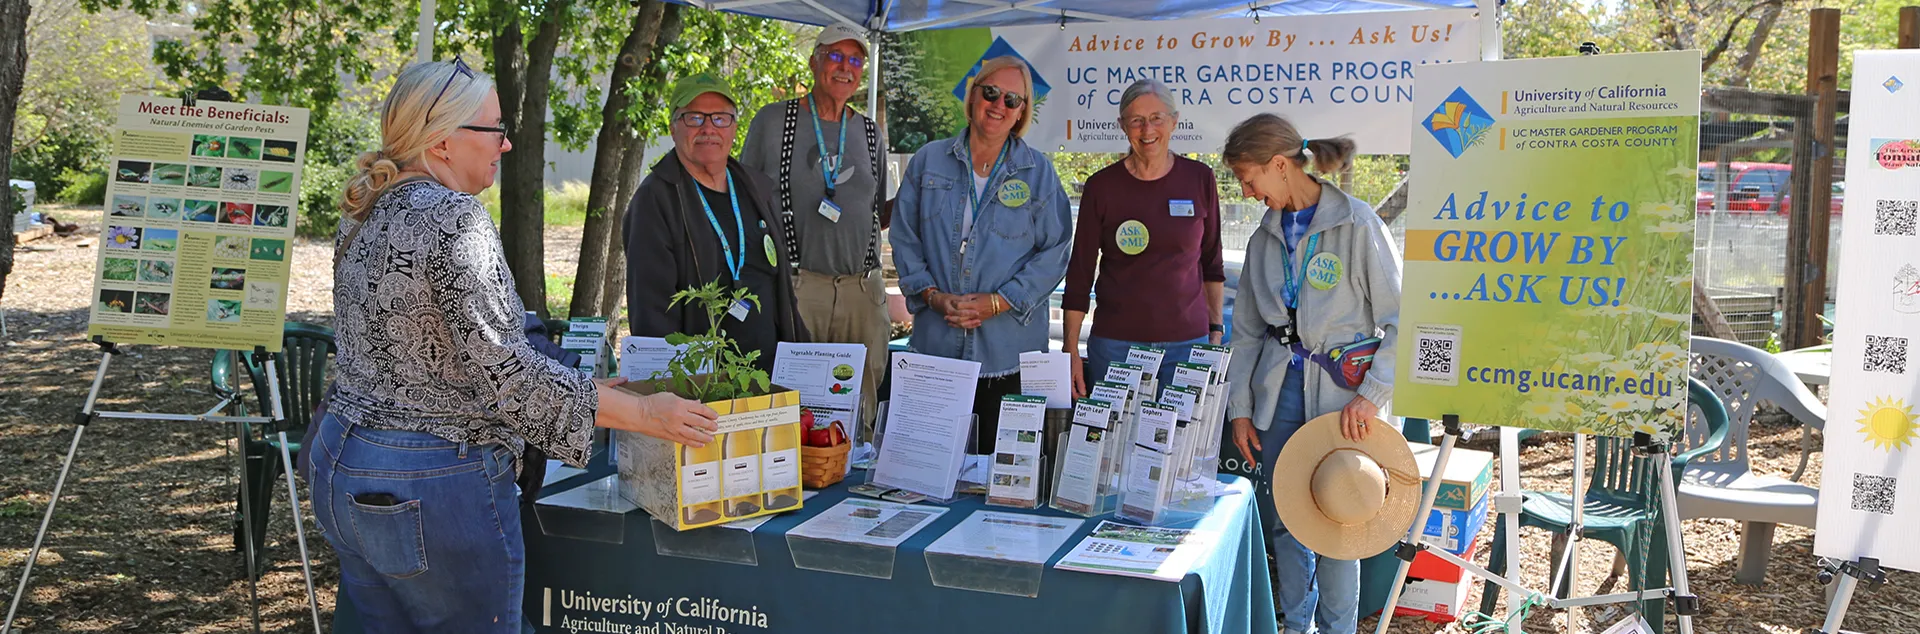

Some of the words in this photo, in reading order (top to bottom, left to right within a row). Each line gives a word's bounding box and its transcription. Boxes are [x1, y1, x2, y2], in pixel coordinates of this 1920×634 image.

[1068, 35, 1145, 52] Advice
[1157, 34, 1178, 50] to
[1191, 31, 1255, 49] Grow
[1266, 29, 1296, 52] By
[1349, 25, 1396, 45] Ask
[1411, 24, 1453, 43] Us!
[1067, 67, 1097, 84] UC
[1107, 66, 1187, 84] MASTER
[1197, 63, 1322, 83] GARDENER
[1332, 60, 1452, 80] PROGR
[1078, 89, 1097, 109] of
[1228, 86, 1314, 105] COSTA
[1330, 85, 1413, 103] COUN
[1514, 87, 1581, 102] University
[1585, 87, 1597, 100] of
[1598, 84, 1667, 99] California
[138, 101, 176, 116] Meet
[180, 105, 204, 118] the
[207, 106, 290, 124] Beneficials:
[1514, 105, 1567, 117] Agriculture
[1568, 102, 1587, 113] and
[1589, 101, 1626, 112] Natural
[1629, 100, 1678, 111] Resources
[150, 118, 181, 127] Natural
[181, 120, 213, 129] Enemies
[214, 123, 224, 131] of
[224, 123, 253, 132] Garden
[254, 126, 275, 134] Pests
[1513, 128, 1528, 138] UC
[1529, 127, 1567, 137] MASTER
[1569, 126, 1623, 136] GARDENER
[1626, 125, 1678, 135] PROGRAM
[1077, 132, 1119, 142] Agriculture
[1169, 133, 1202, 141] esources
[1516, 140, 1527, 151] of
[1529, 139, 1577, 149] CONTRA
[1581, 138, 1620, 148] COSTA
[1624, 137, 1677, 147] COUNTY
[1873, 152, 1920, 161] Tomat
[1002, 183, 1023, 192] ASK
[1433, 190, 1572, 222] Advice
[1591, 195, 1630, 222] to
[1120, 226, 1141, 236] ASK
[1433, 230, 1561, 264] GROW
[1567, 235, 1627, 265] BY
[1312, 256, 1338, 272] ASK
[1316, 269, 1337, 284] ME
[1429, 272, 1547, 304] ...ASK
[1559, 275, 1627, 307] US!
[572, 323, 589, 331] Thrips
[1142, 354, 1157, 362] Borers
[1192, 350, 1205, 358] Deer
[1108, 373, 1126, 382] Mildew
[1110, 368, 1131, 377] Powdery
[1466, 365, 1673, 397] ccmg.ucanr.edu
[1165, 390, 1183, 399] Ground
[1077, 404, 1092, 412] Peach
[1163, 397, 1185, 407] Squirrels
[1142, 408, 1162, 418] Gophers
[1411, 586, 1428, 596] print
[560, 589, 652, 621] University
[656, 598, 673, 618] of
[675, 596, 768, 629] California
[560, 614, 632, 634] Agriculture
[635, 622, 659, 634] and
